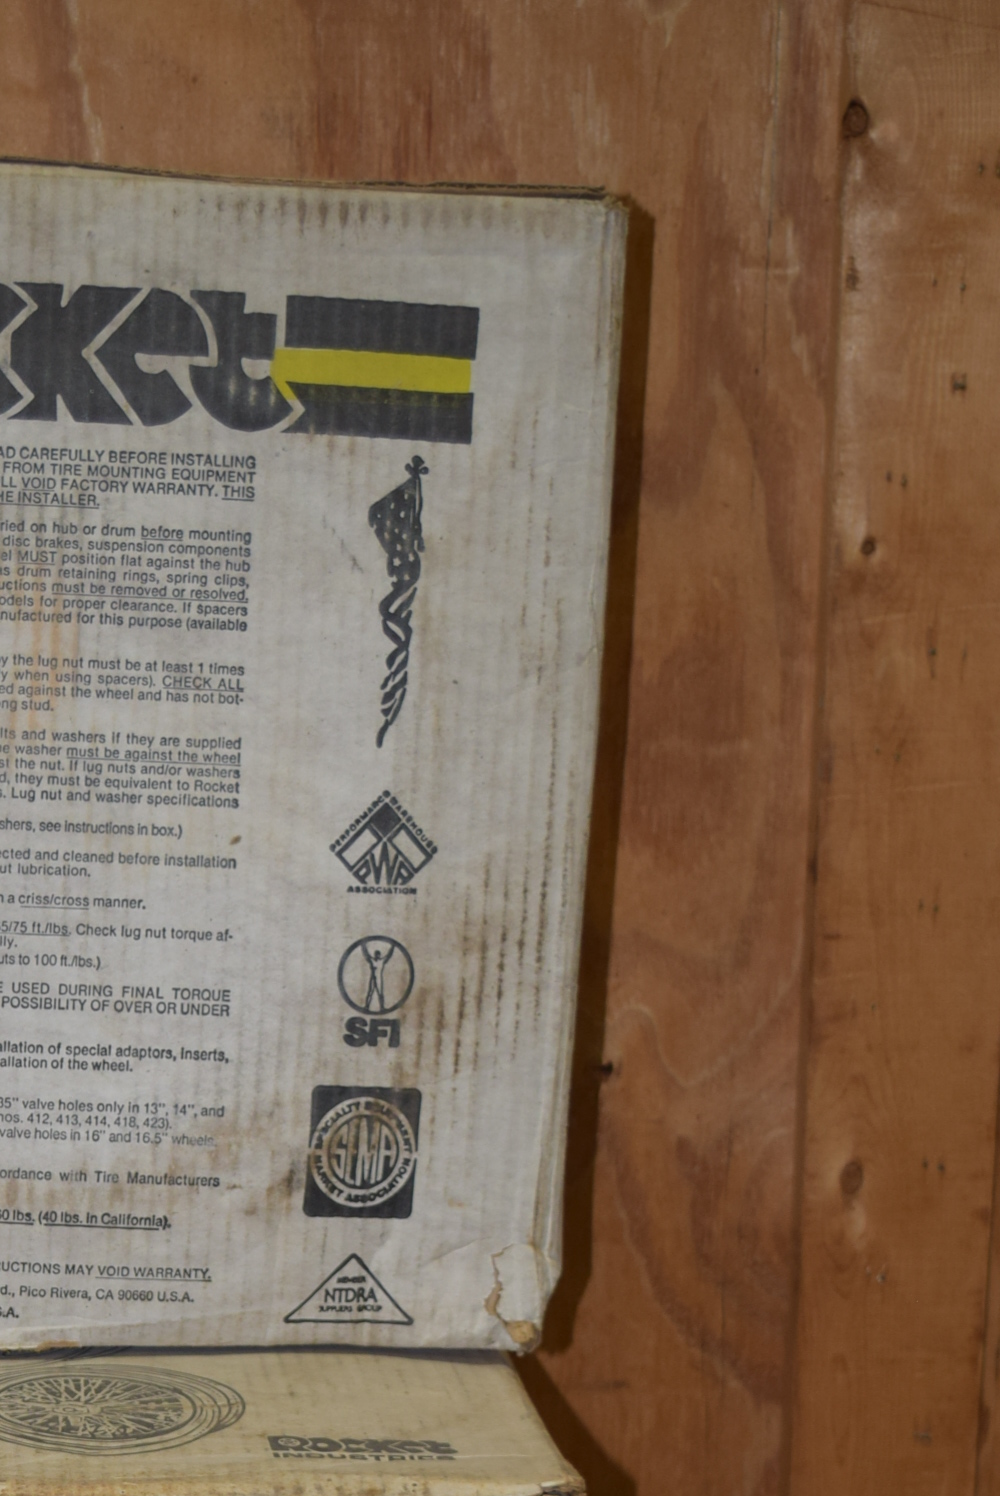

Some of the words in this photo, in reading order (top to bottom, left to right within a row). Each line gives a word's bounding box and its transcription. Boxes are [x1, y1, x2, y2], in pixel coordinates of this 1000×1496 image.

[19, 447, 105, 462] CAREFULLY
[108, 451, 167, 465] BEFORE
[170, 454, 256, 469] INSTALLING
[2, 461, 44, 474] FROM
[50, 463, 81, 475] TIRE
[87, 464, 165, 479] MOUNTING
[171, 468, 256, 483] EQUIPMENT
[21, 477, 56, 489] VOID
[60, 478, 128, 493] FACTORY
[132, 482, 218, 497] WARRANTY.
[223, 486, 255, 499] THIS
[17, 493, 99, 508] INSTALLER.
[2, 535, 30, 547] disc
[35, 536, 82, 552] brakes,
[87, 538, 164, 555] suspension
[168, 542, 251, 559] components
[17, 863, 91, 877] lubrication.
[347, 885, 417, 895] ASSOCIATION
[6, 894, 15, 904] a
[17, 892, 89, 909] criss/cross
[92, 898, 146, 909] manner.
[11, 982, 50, 995] USED
[58, 984, 113, 997] DURING
[121, 986, 164, 999] FINAL
[172, 988, 231, 1002] TORQUE
[343, 1017, 400, 1047] SFI
[50, 1057, 64, 1069] of
[67, 1058, 88, 1070] the
[90, 1059, 133, 1072] wheel.
[64, 1262, 94, 1275] MAY
[97, 1264, 130, 1276] VOID
[133, 1265, 211, 1279] WARRANTY.
[19, 1285, 46, 1297] Pico
[49, 1286, 91, 1301] Rivera,
[95, 1288, 114, 1300] CA
[117, 1288, 154, 1301] 90660
[156, 1290, 194, 1302] U.S.A.
[324, 1287, 377, 1303] NTDRA
